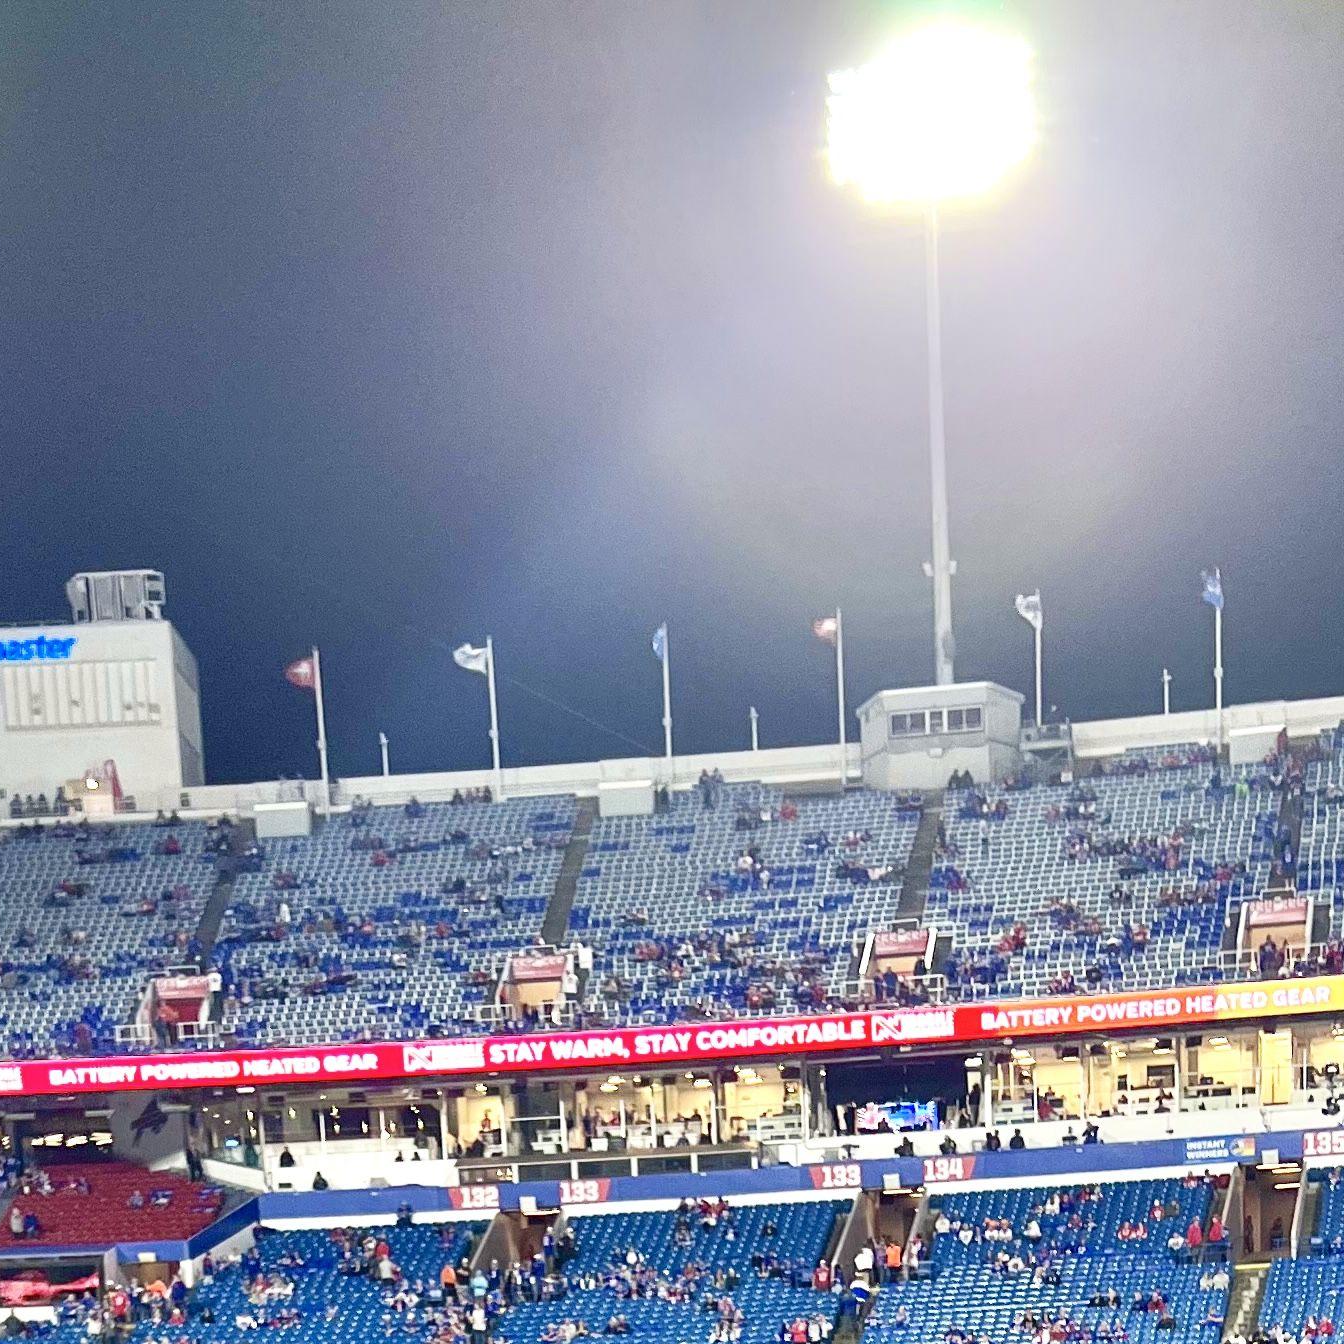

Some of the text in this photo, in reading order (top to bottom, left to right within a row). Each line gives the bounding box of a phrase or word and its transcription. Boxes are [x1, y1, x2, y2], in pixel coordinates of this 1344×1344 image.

[981, 1006, 1073, 1031] BATTERY
[1077, 997, 1181, 1024] POWERED
[1185, 991, 1269, 1014] HEATED
[1273, 986, 1331, 1007] GEAR
[489, 1041, 547, 1064] STAY
[550, 1036, 630, 1060] WARM,
[634, 1031, 693, 1054] STAY
[696, 1020, 866, 1050] COMFORTABLE
[49, 1053, 378, 1087] BATTERY POWERED HEATED GEAR
[822, 1165, 860, 1188] 133
[925, 1159, 964, 1182] 134
[459, 1186, 499, 1209] 132
[560, 1180, 600, 1203] 133
